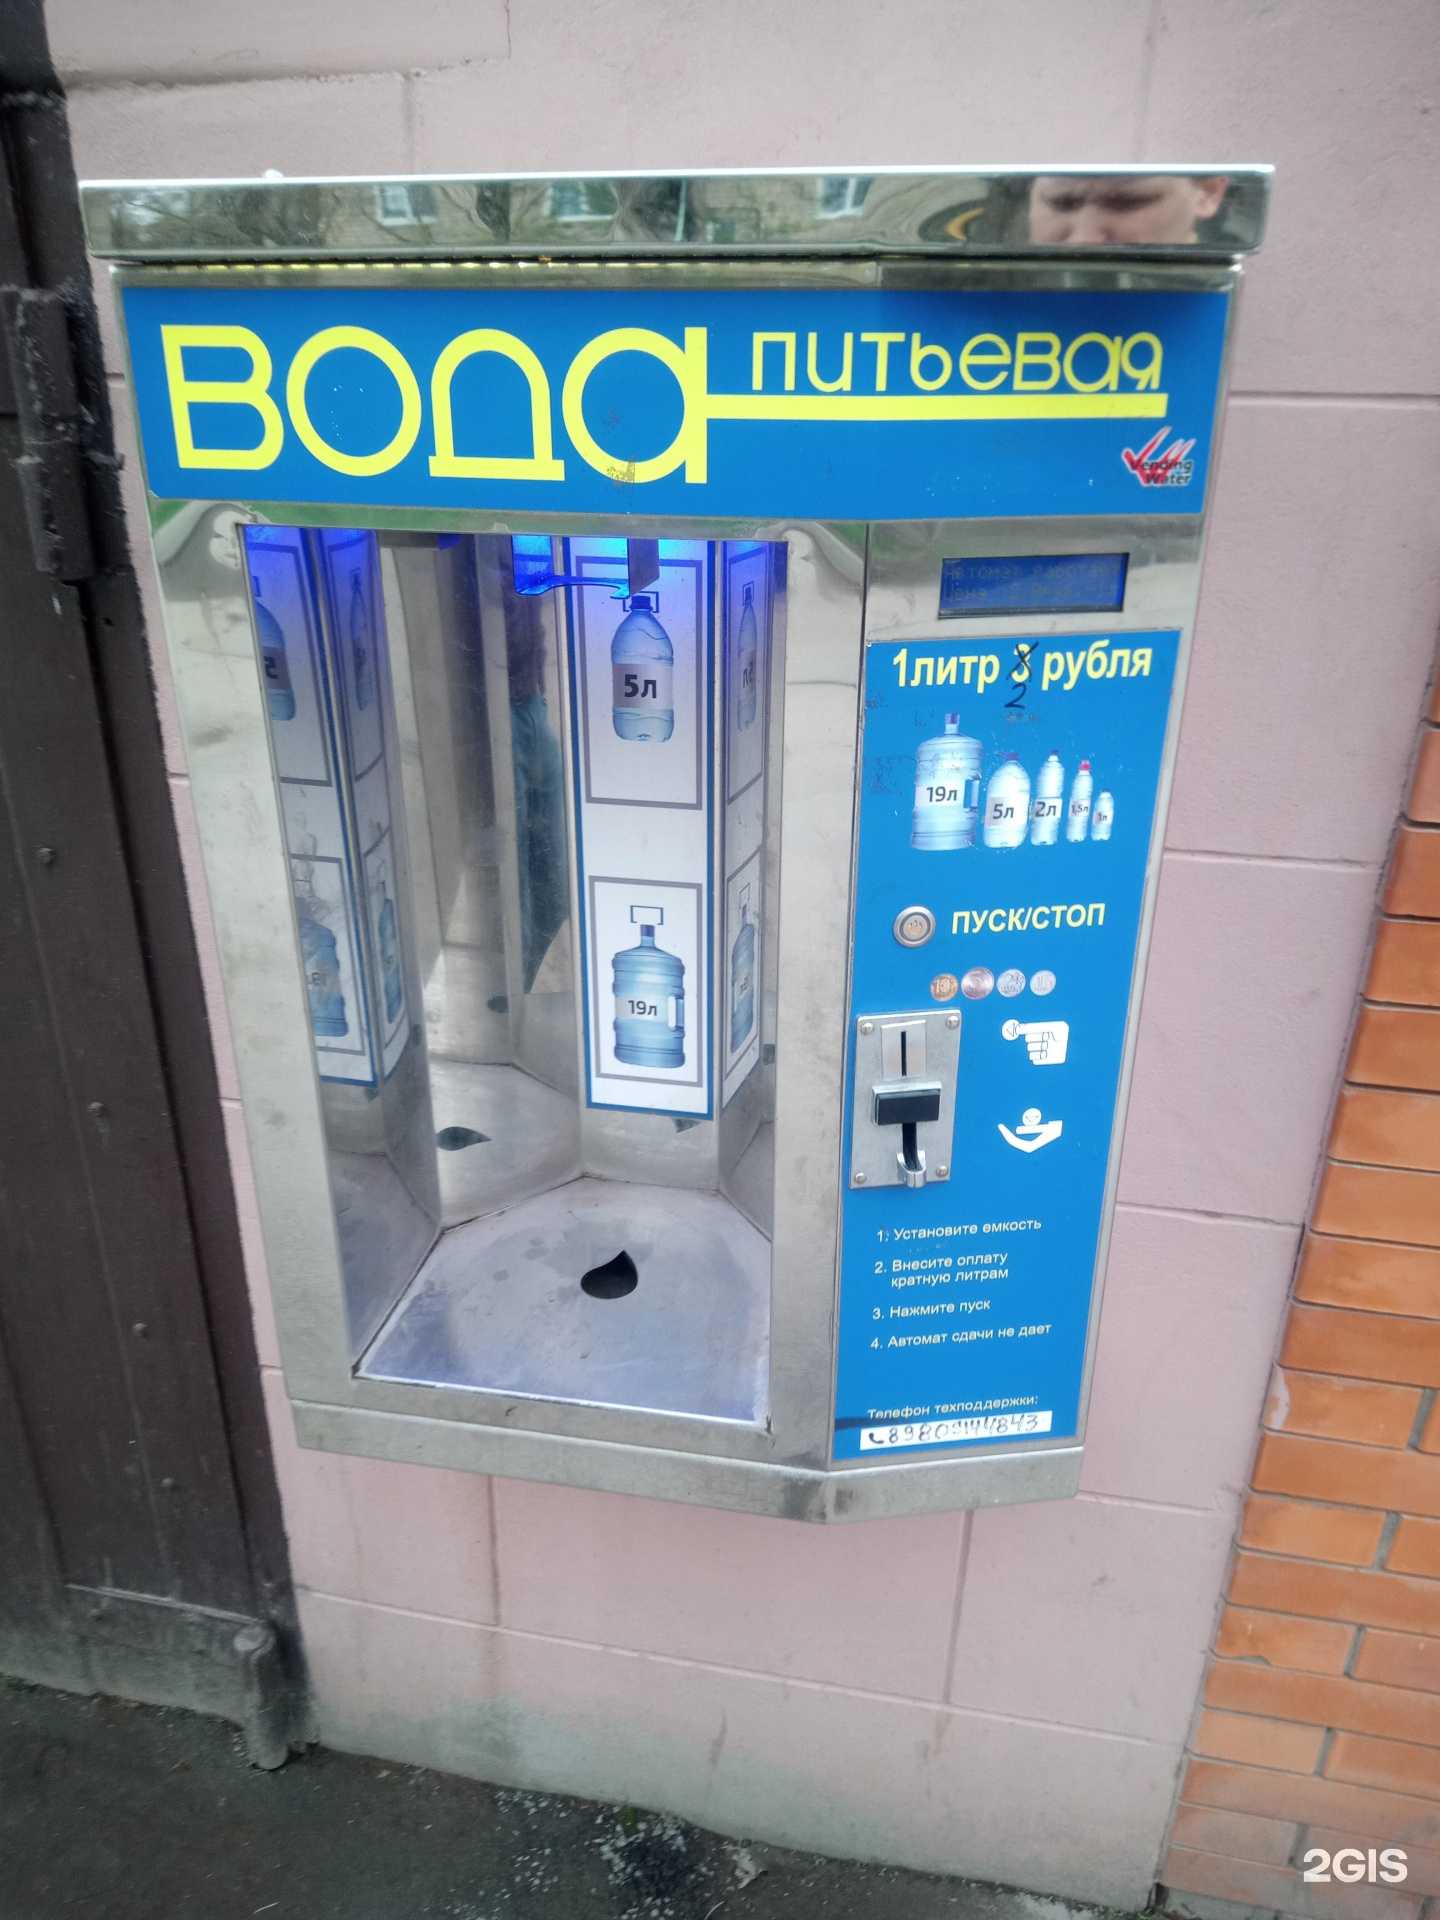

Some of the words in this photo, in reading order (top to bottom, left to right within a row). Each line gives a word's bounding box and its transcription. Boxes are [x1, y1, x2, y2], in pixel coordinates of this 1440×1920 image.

[1041, 639, 1153, 691] рубля
[623, 673, 657, 699] 5л
[1004, 683, 1026, 709] 2
[926, 786, 957, 803] 19л
[992, 803, 1015, 820] 5л
[1035, 801, 1057, 818] 2л
[951, 903, 1105, 934] ПУСК/СТОП
[628, 1000, 657, 1017] 19л
[894, 1225, 978, 1241] Установите
[983, 1218, 1042, 1233] емкость
[874, 1262, 887, 1275] 2.
[892, 1258, 952, 1273] Внесите
[957, 1252, 1009, 1268] оплату
[891, 1273, 951, 1289] кратную
[955, 1268, 1009, 1284] литрам
[872, 1307, 885, 1320] 3.
[889, 1303, 954, 1319] Нажмите
[959, 1299, 991, 1313] пуск
[870, 1337, 883, 1350] 4.
[888, 1332, 947, 1348] Автомат
[952, 1328, 993, 1343] сдачи
[998, 1326, 1014, 1338] не
[1018, 1323, 1052, 1337] дает
[868, 1405, 929, 1420] Телефон
[934, 1396, 1039, 1416] техподдержки:
